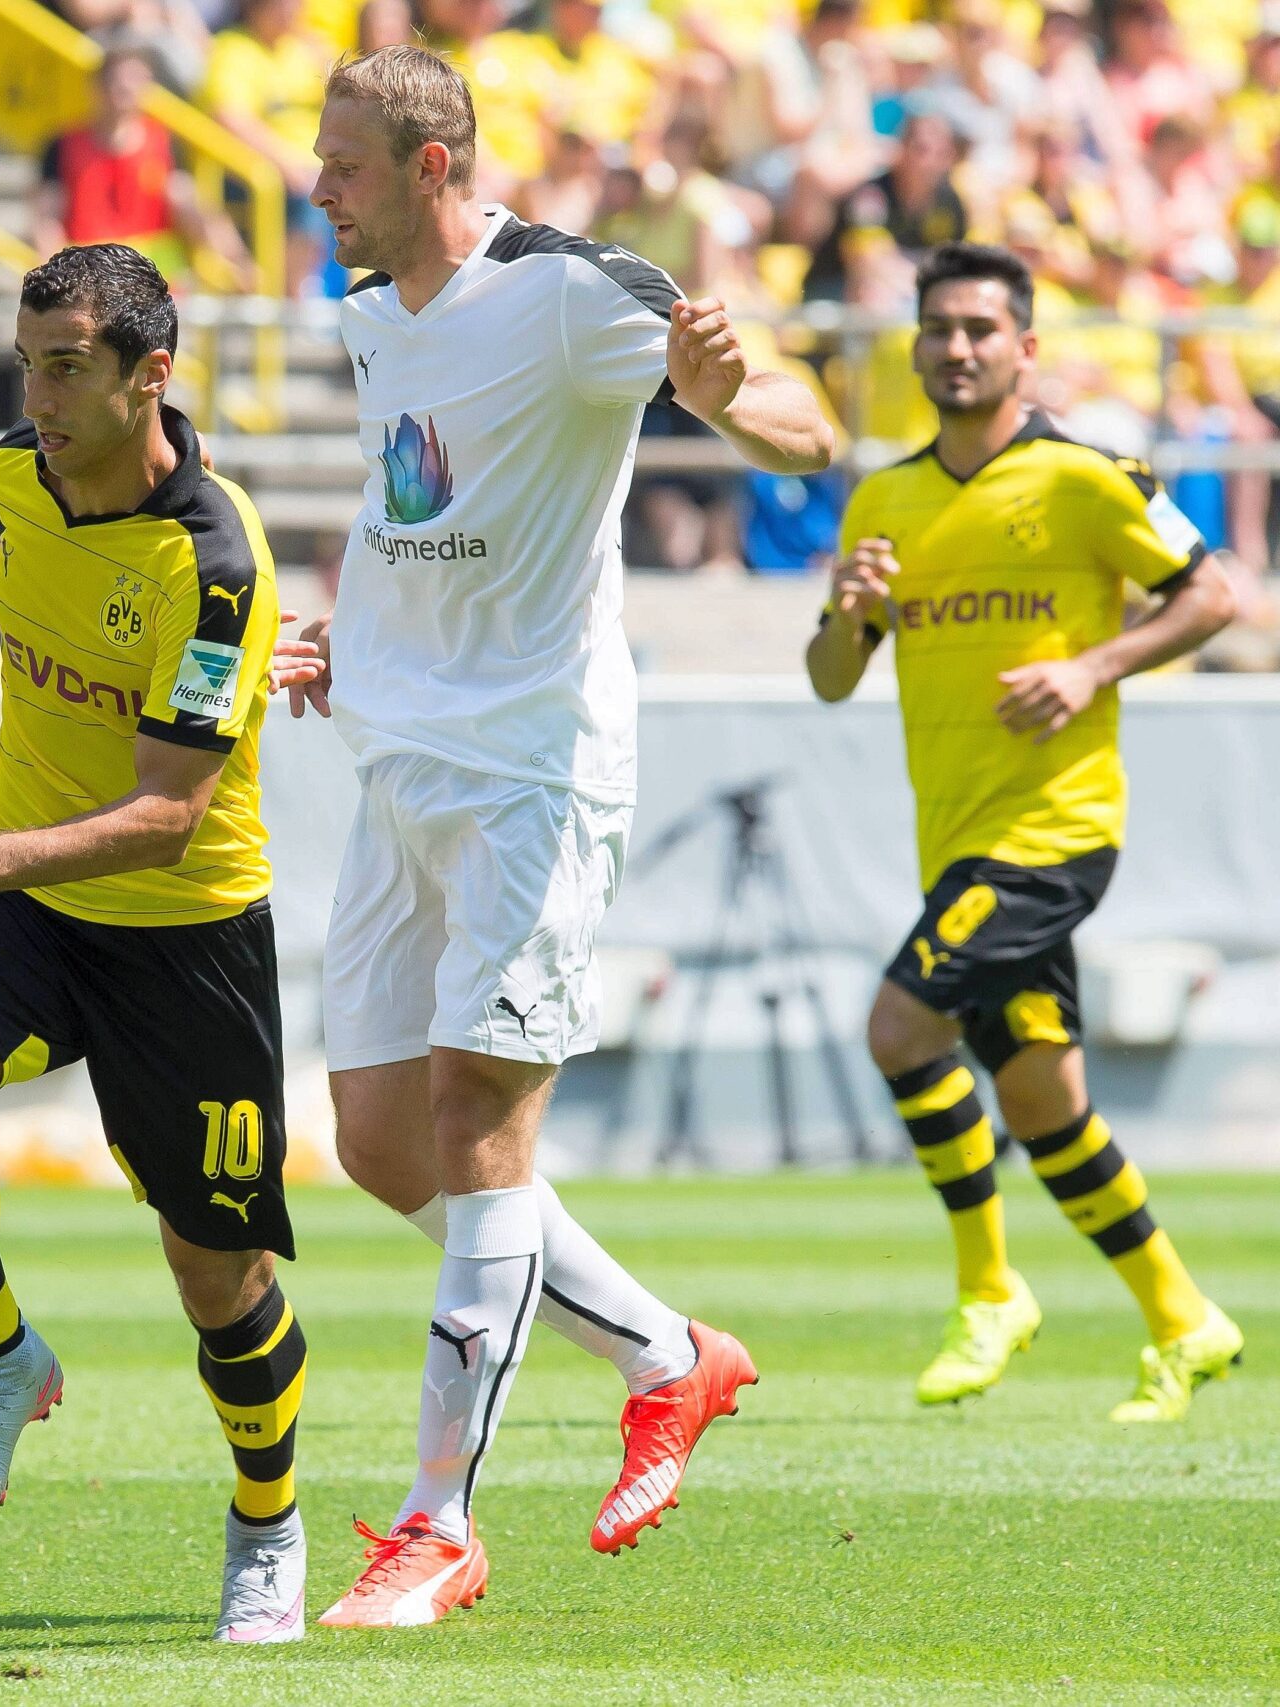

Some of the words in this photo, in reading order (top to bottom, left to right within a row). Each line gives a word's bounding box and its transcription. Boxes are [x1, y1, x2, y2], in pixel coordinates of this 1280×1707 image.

[106, 595, 142, 635] BVB
[114, 628, 129, 643] 09
[902, 589, 1058, 630] EVONIK
[5, 632, 145, 718] EVONI
[174, 683, 232, 708] Hermes
[936, 884, 998, 948] 8
[198, 1100, 263, 1180] 10
[597, 1456, 681, 1539] PUMA
